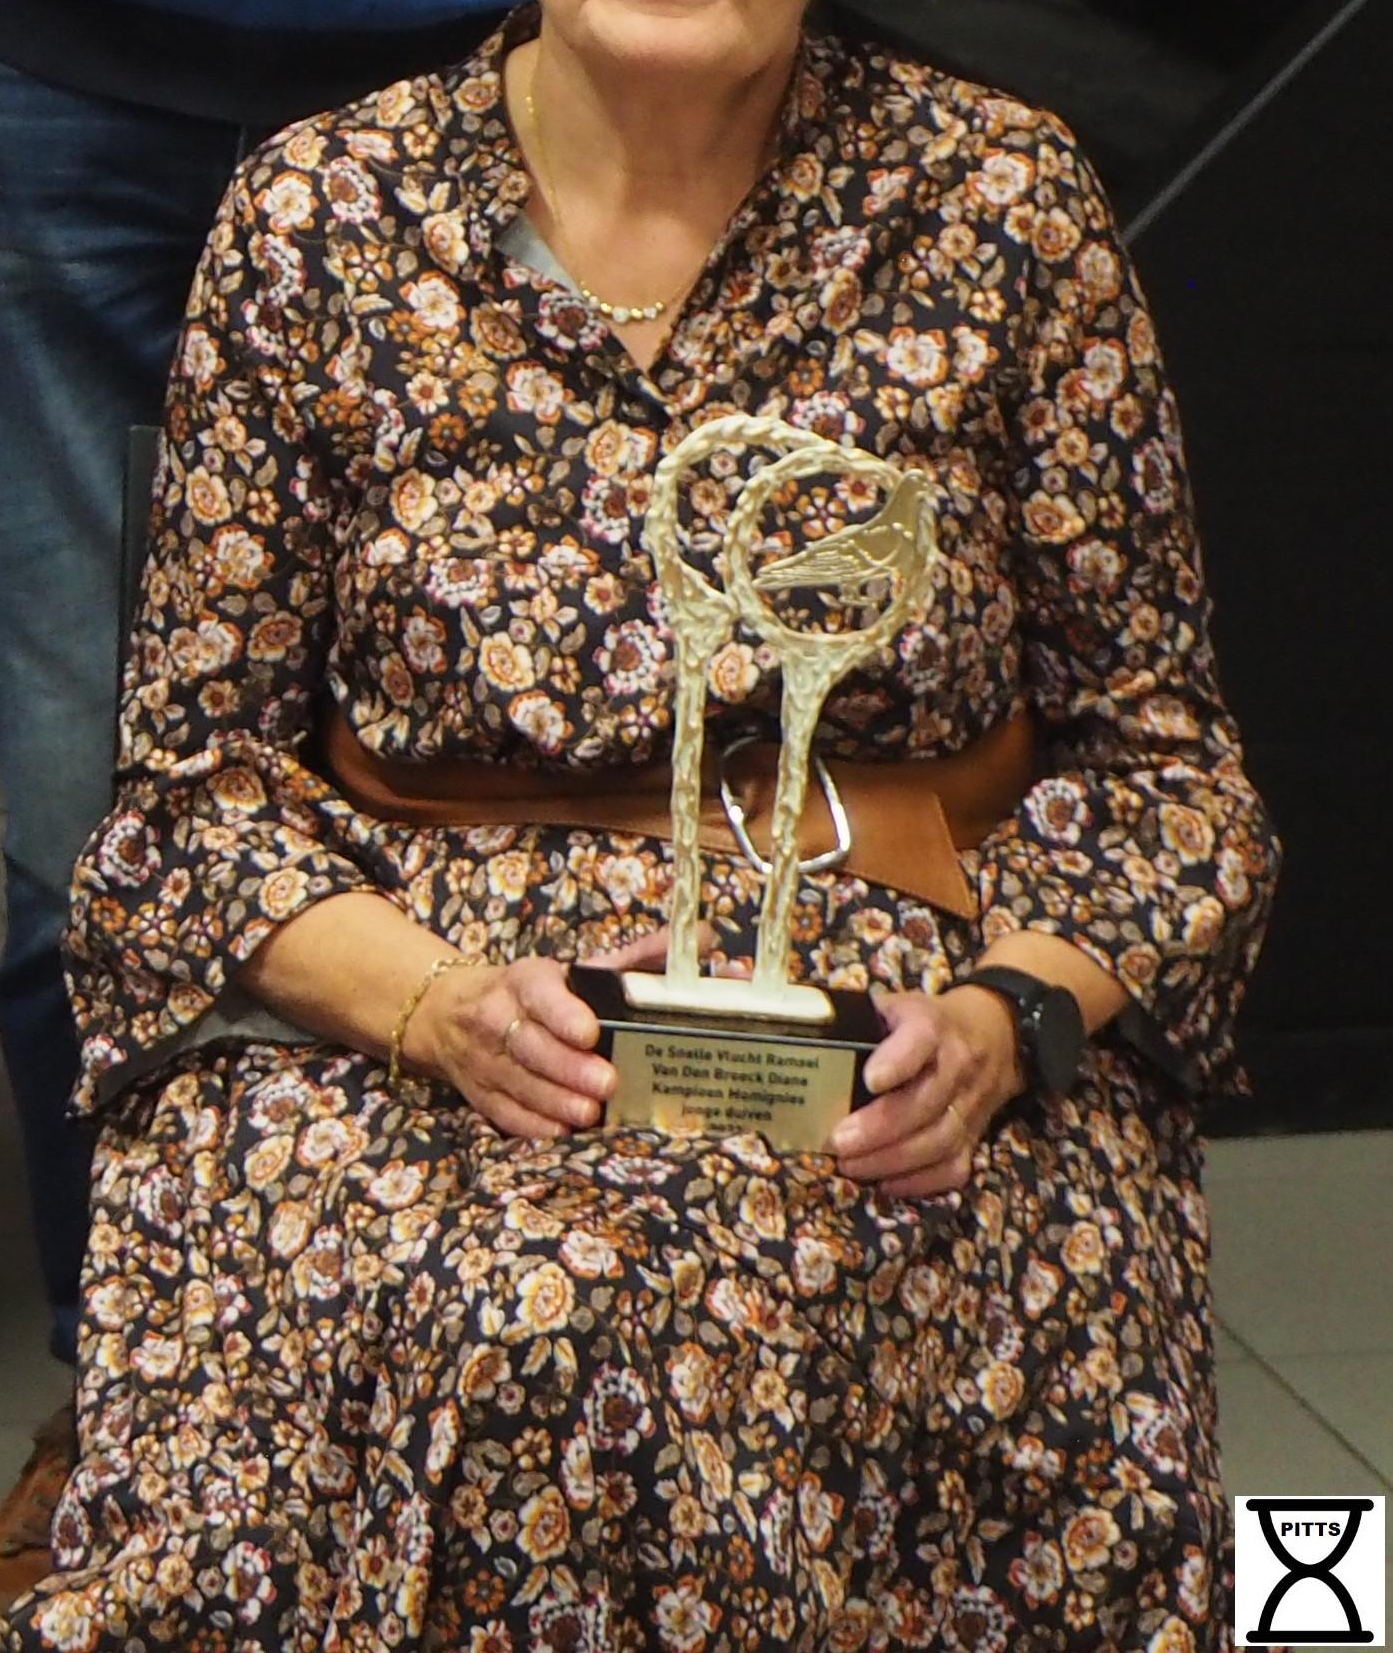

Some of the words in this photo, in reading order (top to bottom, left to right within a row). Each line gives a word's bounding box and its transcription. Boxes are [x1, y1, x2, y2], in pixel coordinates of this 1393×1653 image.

[645, 1044, 663, 1057] De
[766, 1053, 819, 1069] Ramsel
[652, 1063, 678, 1076] Van
[682, 1066, 710, 1078] Den
[652, 1082, 723, 1098] Kampioen
